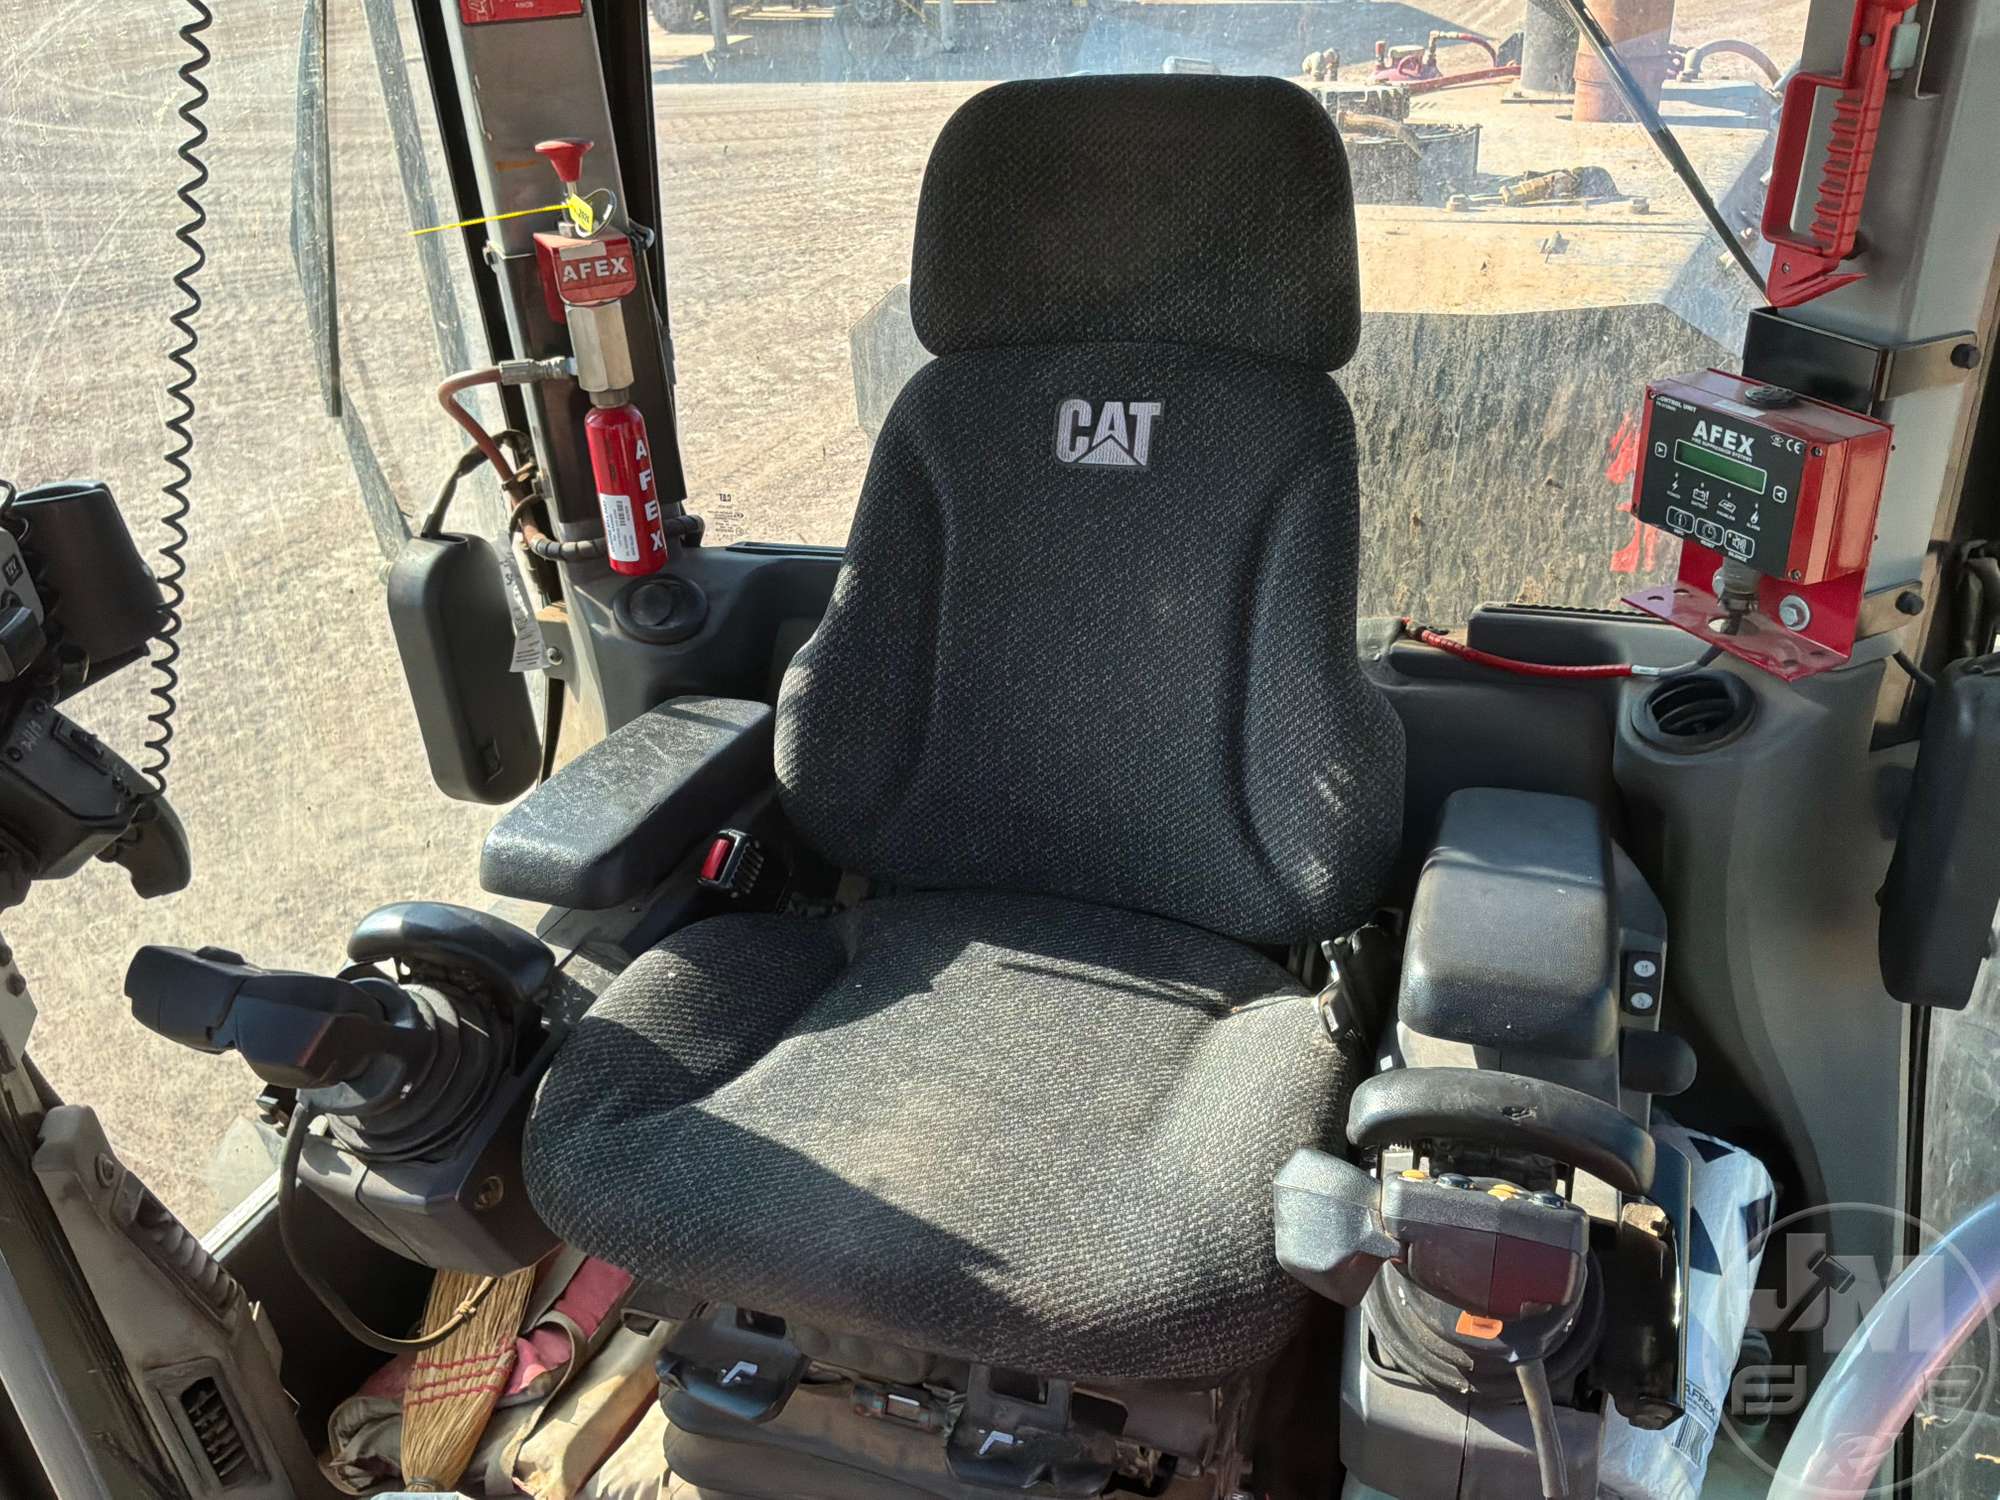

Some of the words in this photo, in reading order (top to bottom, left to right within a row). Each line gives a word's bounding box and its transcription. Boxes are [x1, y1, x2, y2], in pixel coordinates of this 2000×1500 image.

[562, 256, 628, 282] AFEX
[1056, 399, 1161, 466] CAT
[1692, 420, 1755, 456] AFEX
[636, 438, 664, 553] AFEX
